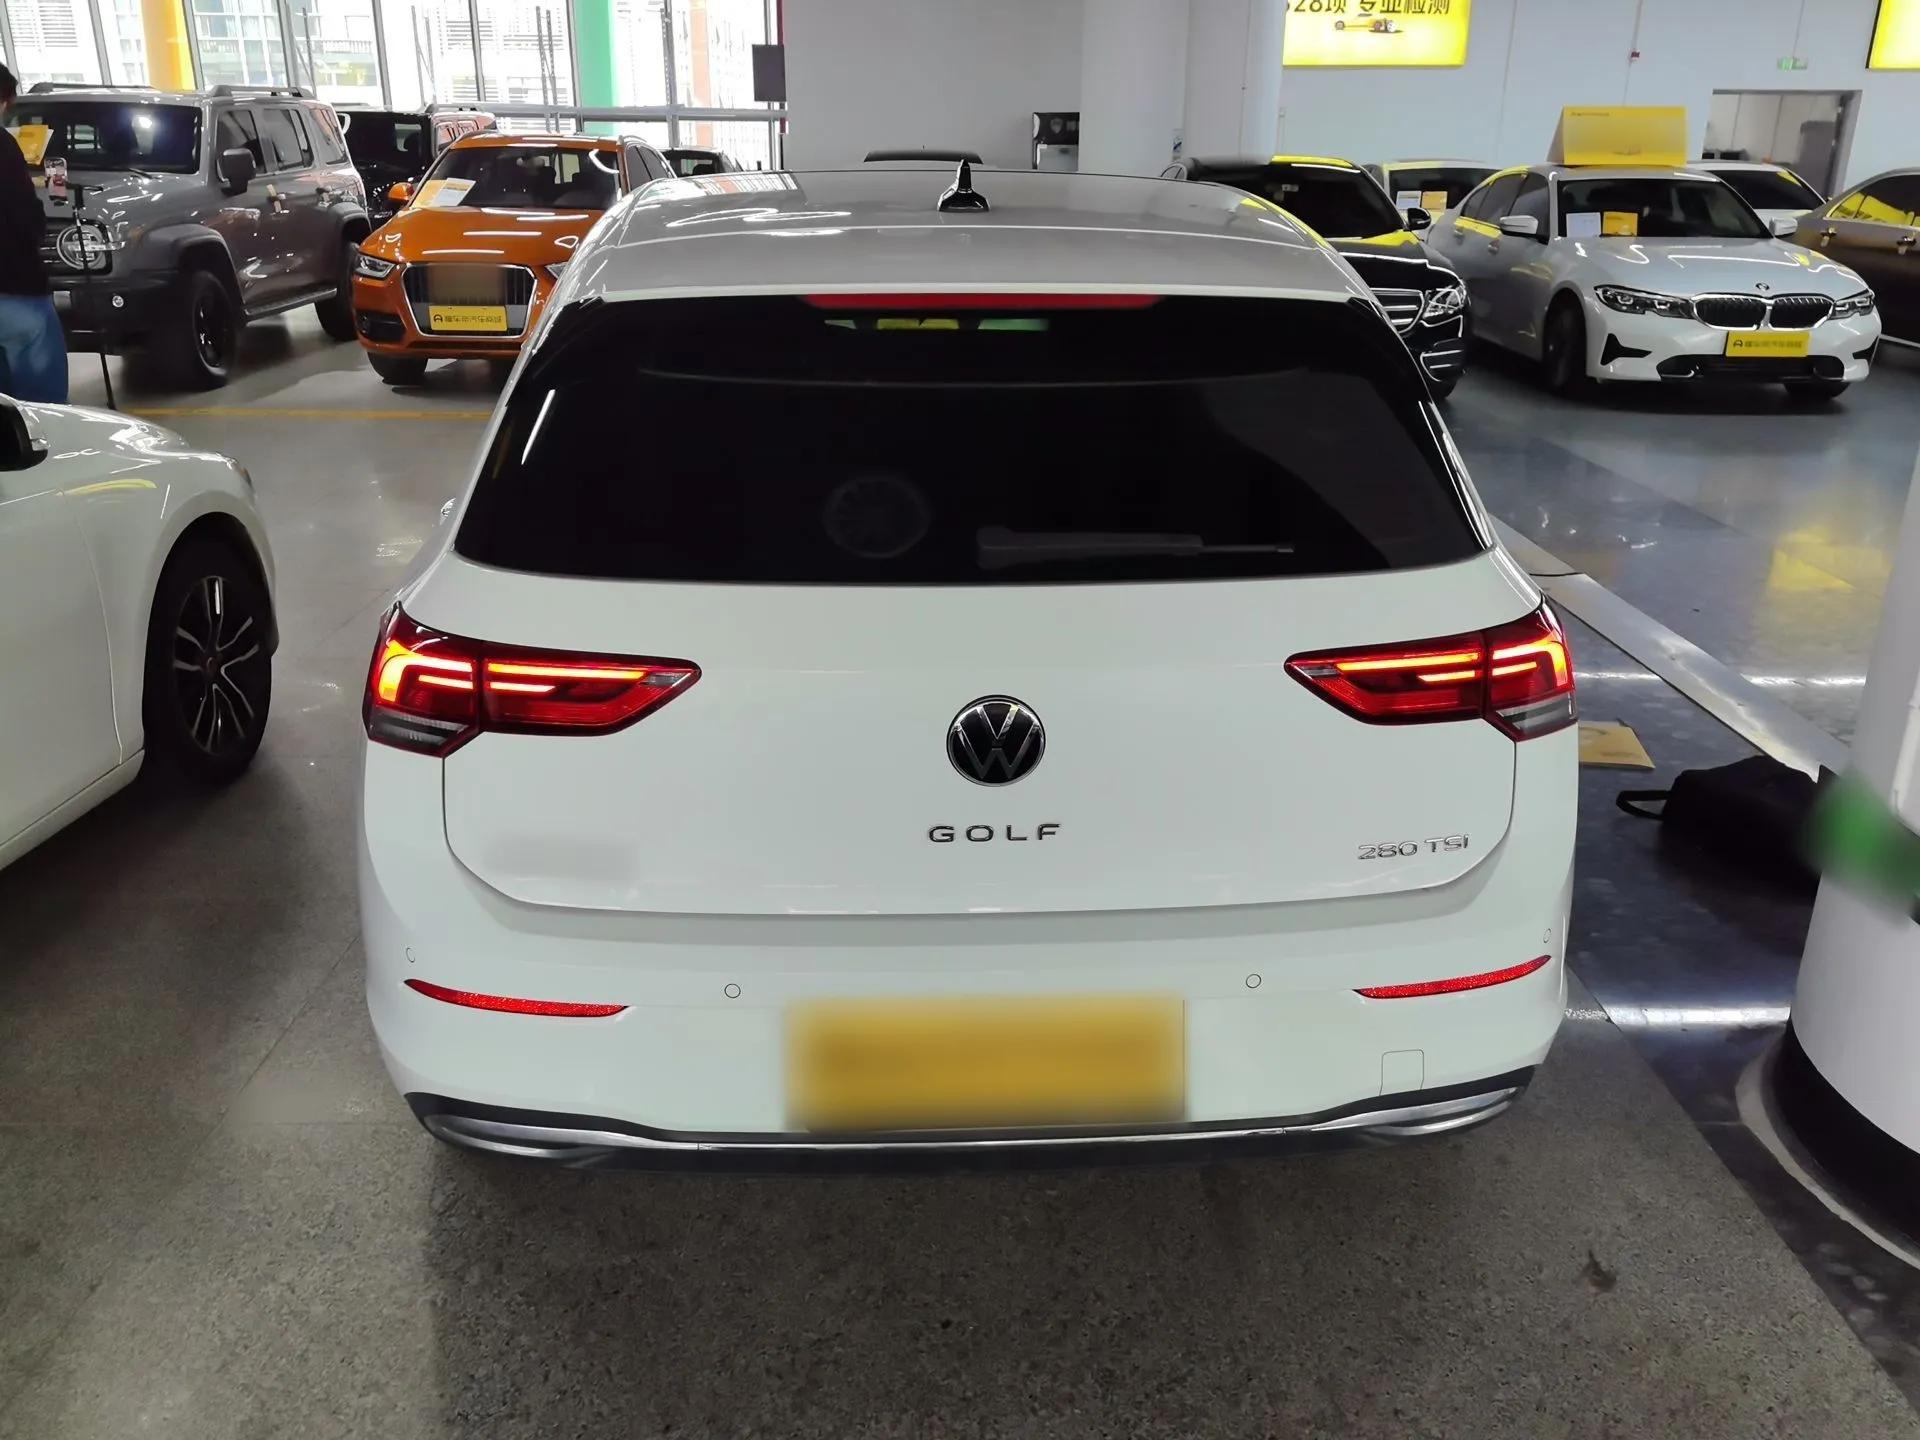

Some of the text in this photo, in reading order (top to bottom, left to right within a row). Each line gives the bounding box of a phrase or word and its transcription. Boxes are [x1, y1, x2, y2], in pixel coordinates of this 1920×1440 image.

[1287, 0, 1346, 13] 28项
[928, 823, 1061, 843] GOLF
[1358, 834, 1469, 860] 280 TSI
